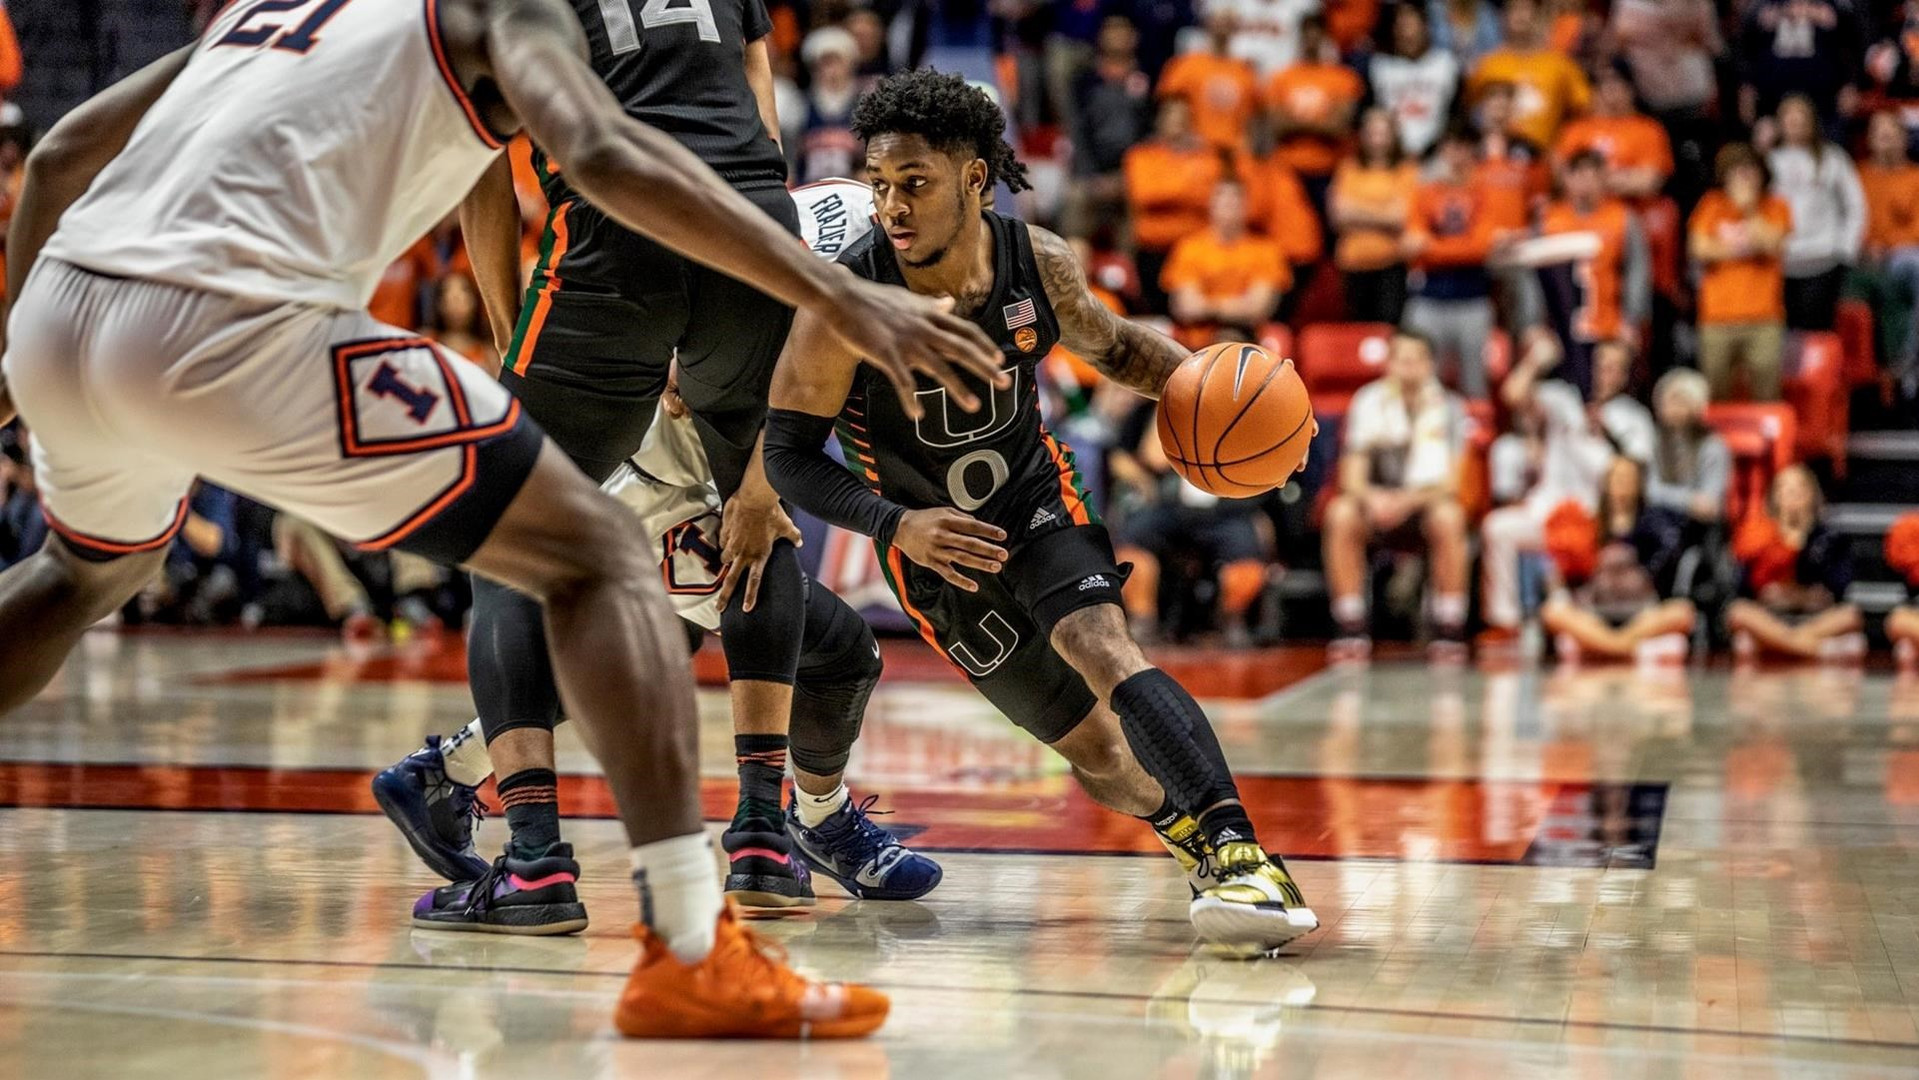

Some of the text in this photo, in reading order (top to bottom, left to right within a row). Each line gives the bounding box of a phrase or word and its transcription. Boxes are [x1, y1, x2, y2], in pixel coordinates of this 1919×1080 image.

[598, 0, 722, 56] 14
[809, 192, 848, 253] FRAZIER
[912, 364, 1020, 449] U
[1029, 512, 1056, 530] adidas
[1078, 579, 1110, 591] adidas
[947, 608, 1020, 677] U
